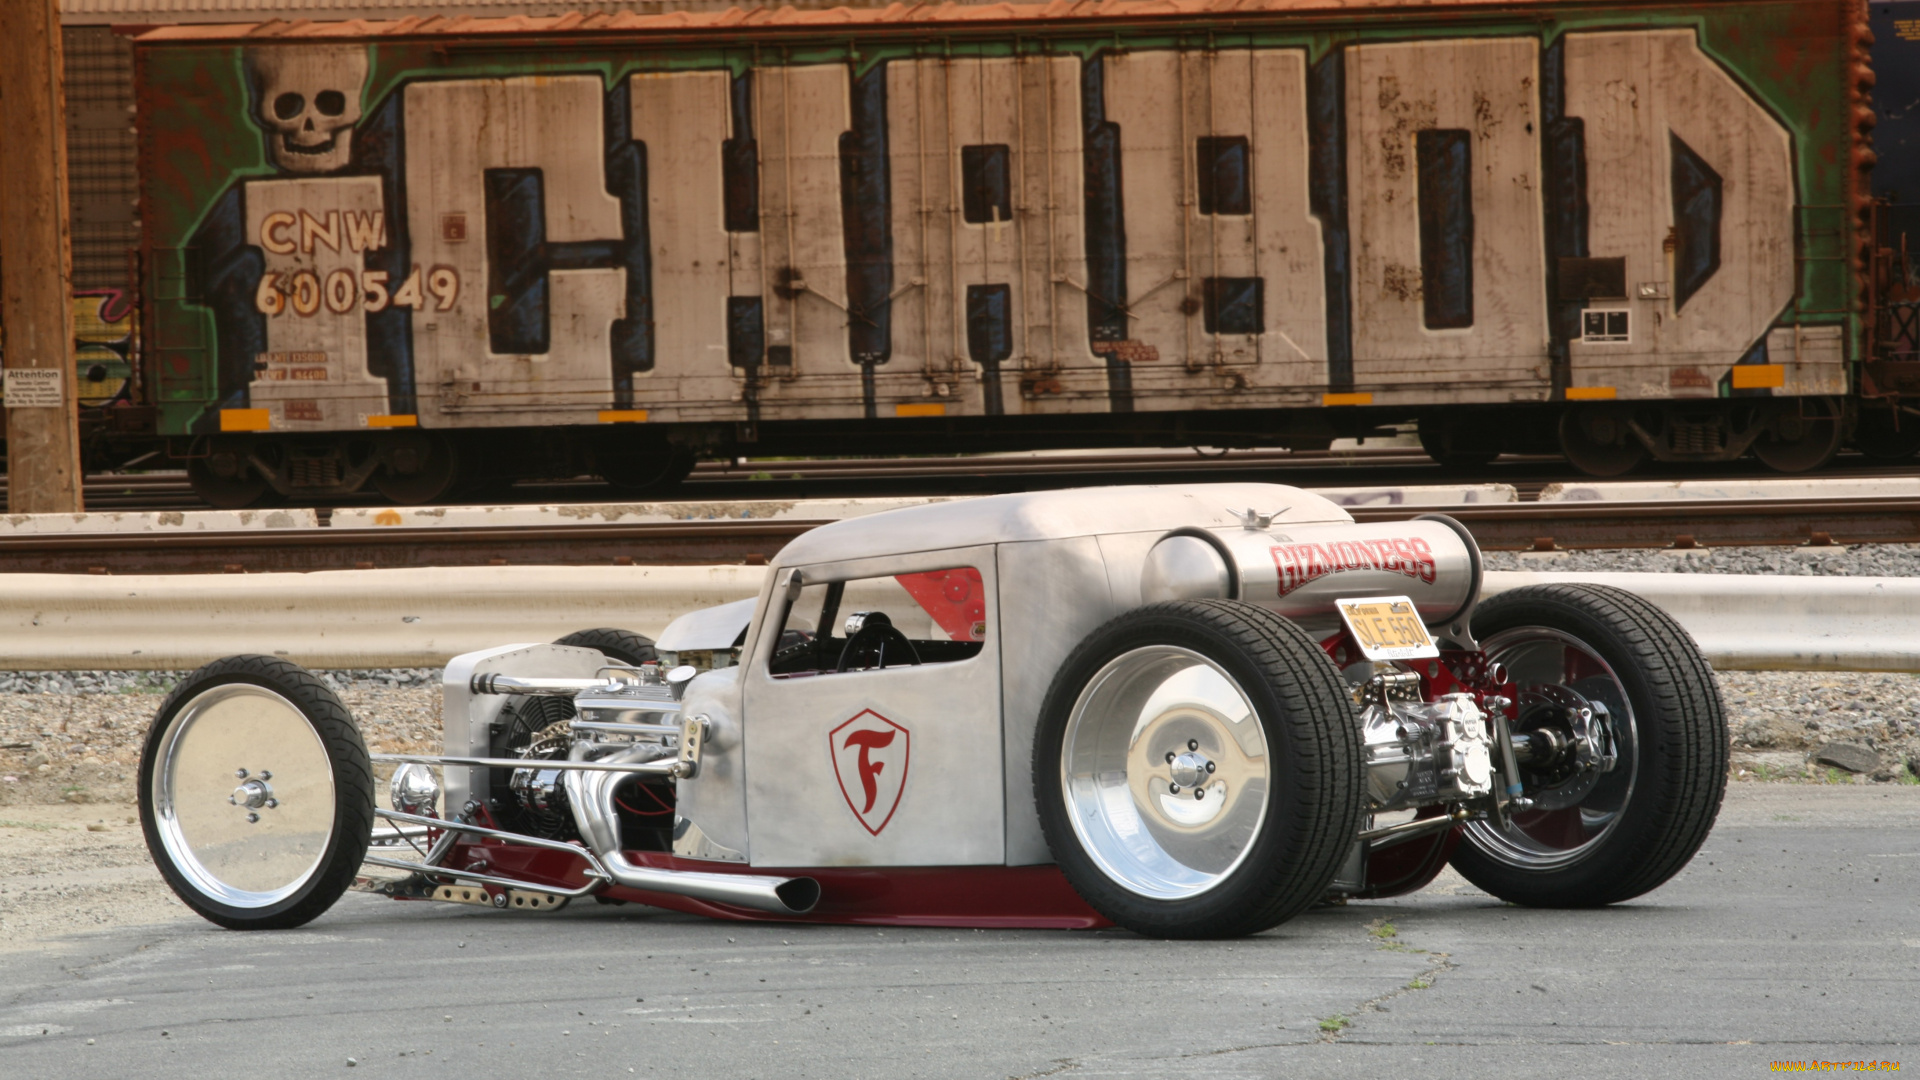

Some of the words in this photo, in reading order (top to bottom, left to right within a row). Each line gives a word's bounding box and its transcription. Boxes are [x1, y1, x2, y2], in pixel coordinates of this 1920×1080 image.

[260, 208, 387, 255] CNW
[255, 263, 460, 318] 600549
[8, 370, 58, 379] Attention
[1269, 537, 1437, 598] GIZMONESS
[1353, 617, 1395, 646] SLE
[1387, 616, 1425, 645] 550
[843, 728, 896, 814] F
